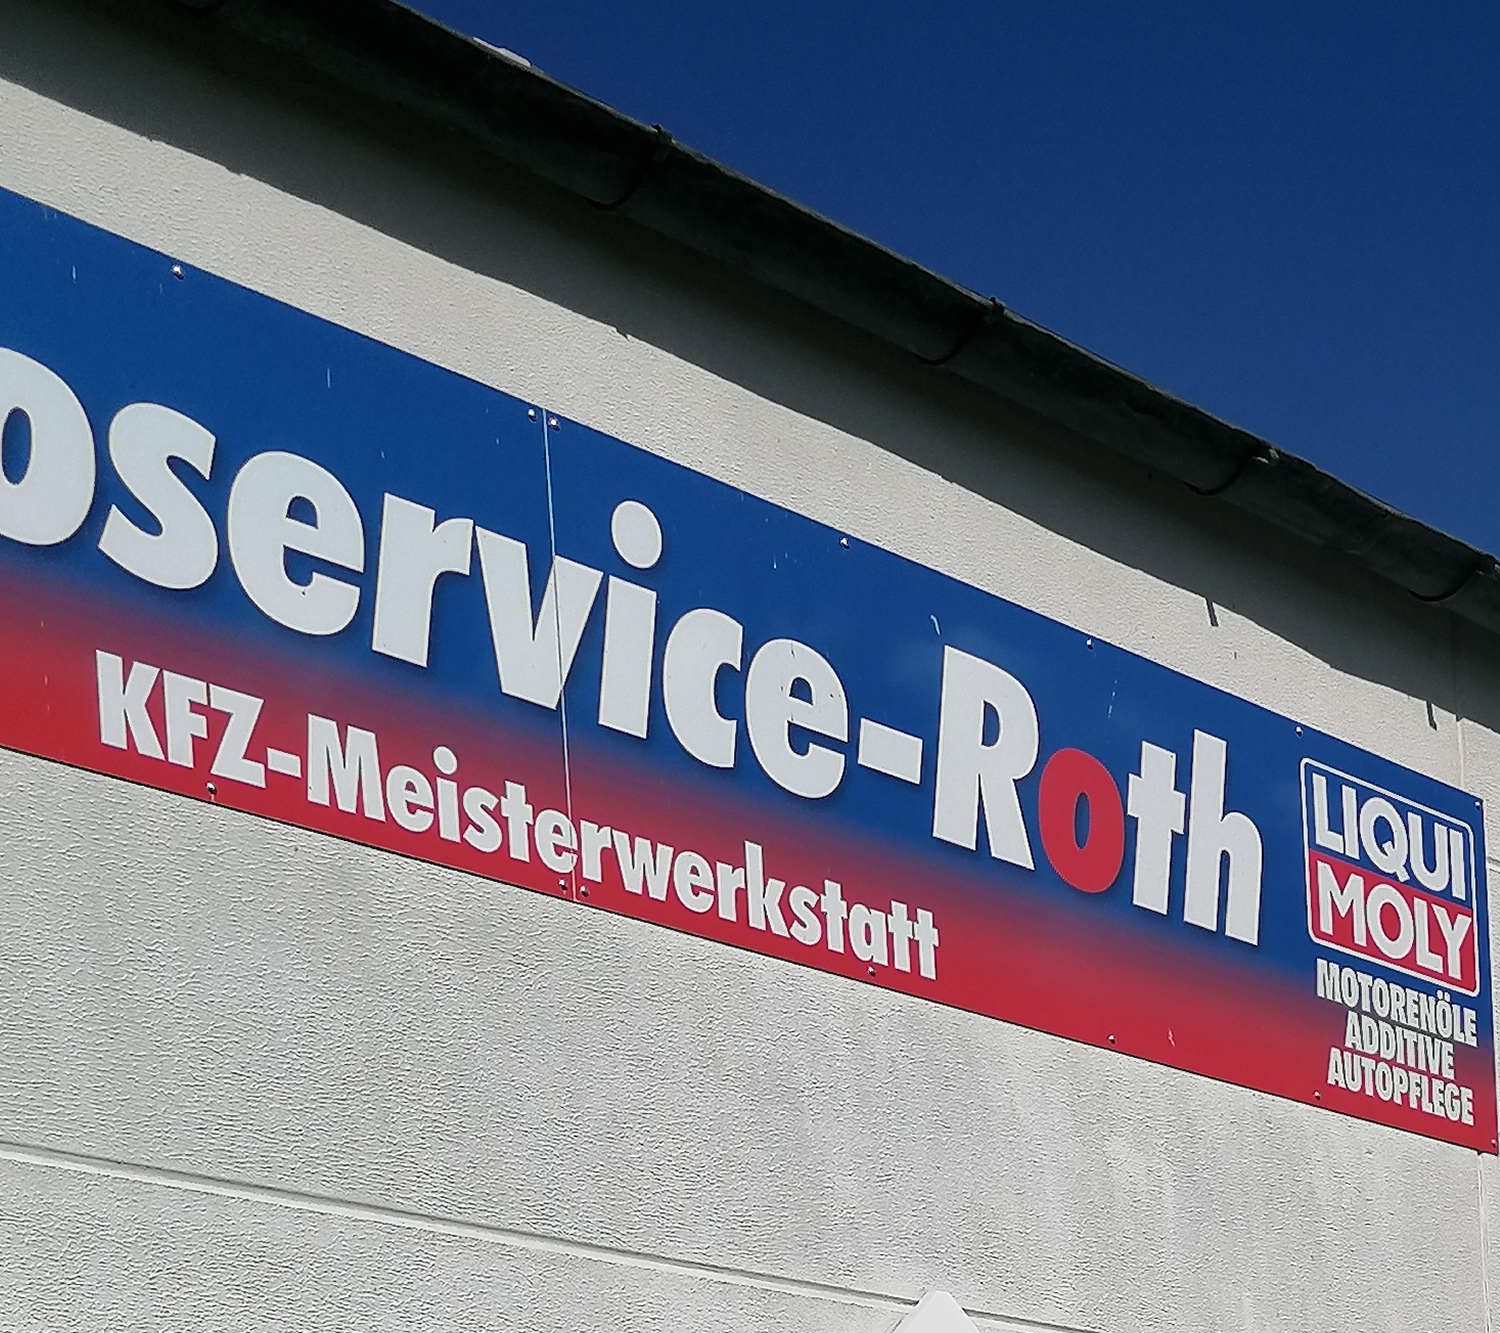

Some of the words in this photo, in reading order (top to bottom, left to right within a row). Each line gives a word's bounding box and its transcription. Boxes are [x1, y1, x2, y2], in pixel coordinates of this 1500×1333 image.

[95, 649, 939, 980] KFZ-Meisterwerkstatt
[1311, 772, 1467, 900] LIQUI
[1316, 859, 1473, 980] MOLY
[1316, 958, 1478, 1048] MOTORENÖLE
[1344, 1010, 1455, 1080] ADDITIVE
[1327, 1047, 1475, 1126] AUTOPFLEGE
